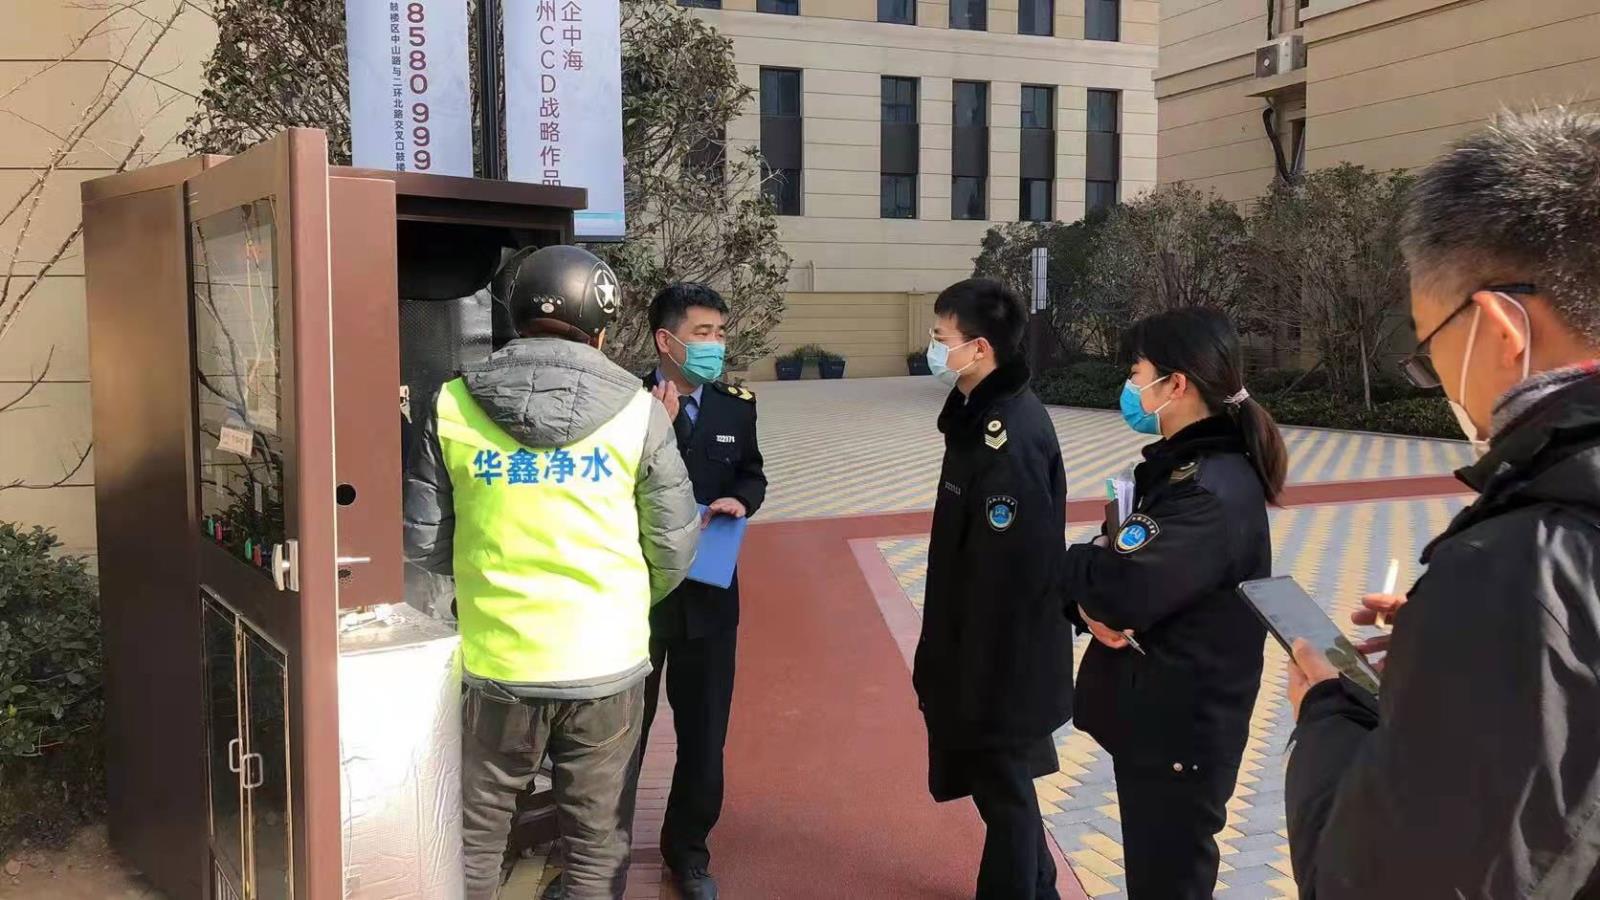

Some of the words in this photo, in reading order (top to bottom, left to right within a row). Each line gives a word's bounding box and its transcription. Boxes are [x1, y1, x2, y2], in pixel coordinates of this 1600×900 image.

[561, 1, 584, 71] 企中海
[536, 0, 561, 186] 州CCD战略作品
[473, 447, 613, 485] 华鑫净水
